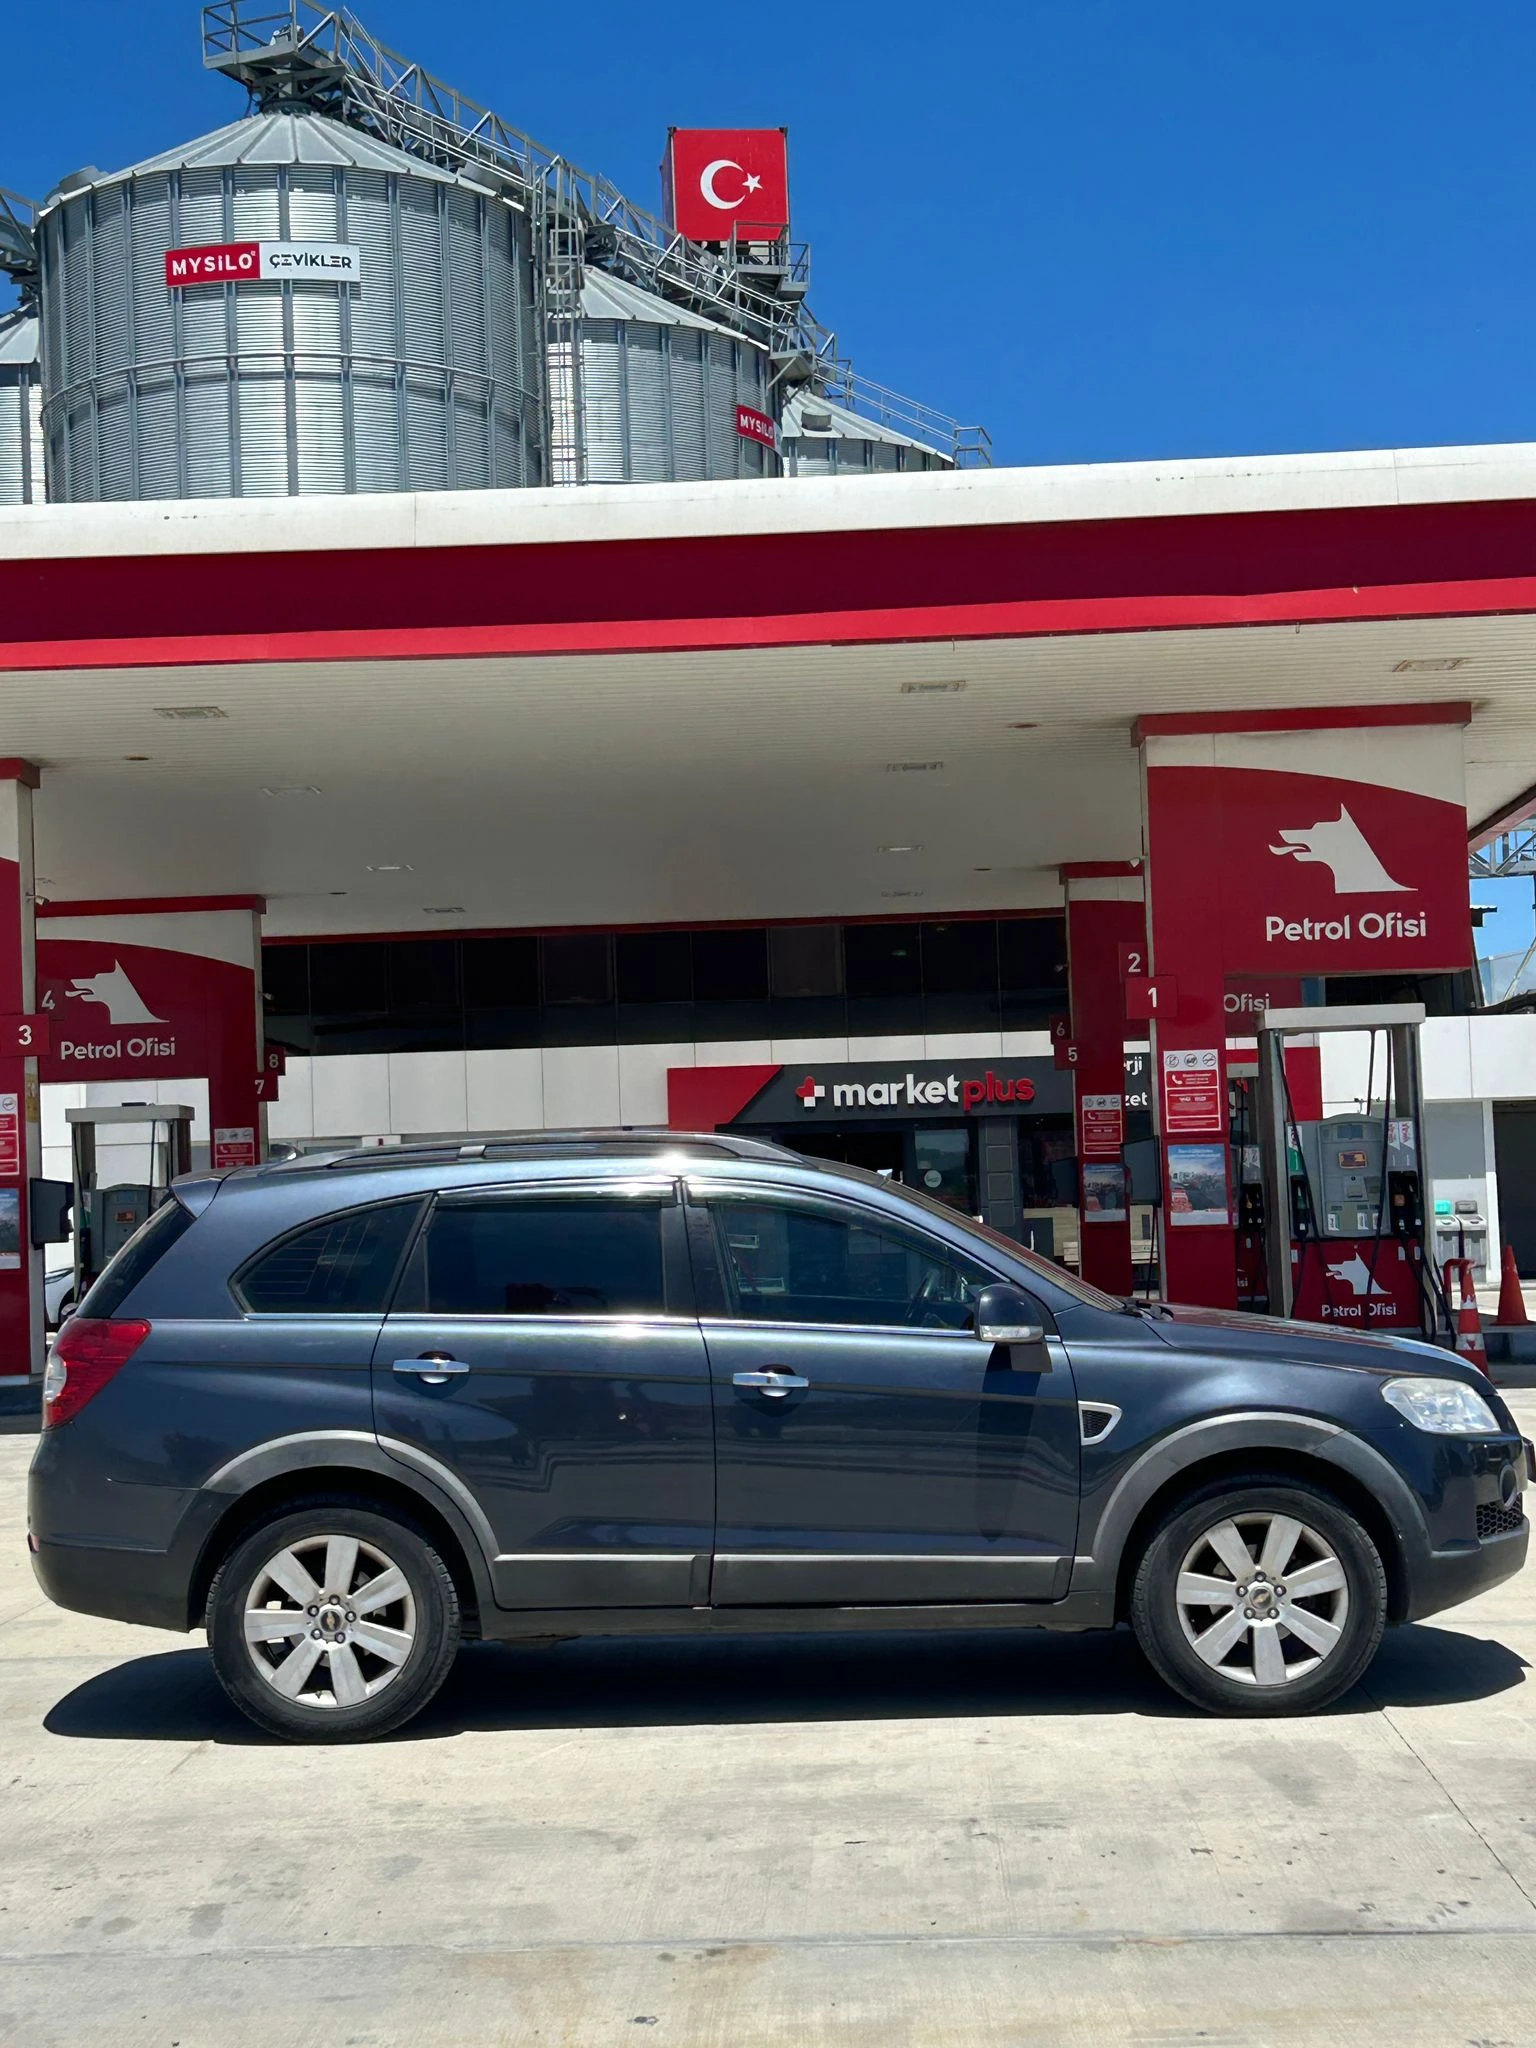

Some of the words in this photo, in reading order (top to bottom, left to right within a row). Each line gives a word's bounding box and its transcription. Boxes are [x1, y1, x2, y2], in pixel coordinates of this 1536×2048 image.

[1266, 914, 1351, 942] Petrol
[1358, 911, 1426, 939] Ofisi
[1128, 953, 1141, 972] 2
[41, 990, 56, 1010] 4
[1147, 987, 1157, 1008] 1
[1224, 993, 1270, 1012] Ofisi
[18, 1024, 32, 1046] 3
[1056, 1021, 1065, 1036] 6
[61, 1040, 122, 1060] Petrol
[127, 1037, 175, 1057] Ofisi
[1068, 1047, 1078, 1062] 5
[269, 1053, 279, 1068] 8
[1124, 1056, 1143, 1076] rji
[254, 1079, 265, 1094] 7
